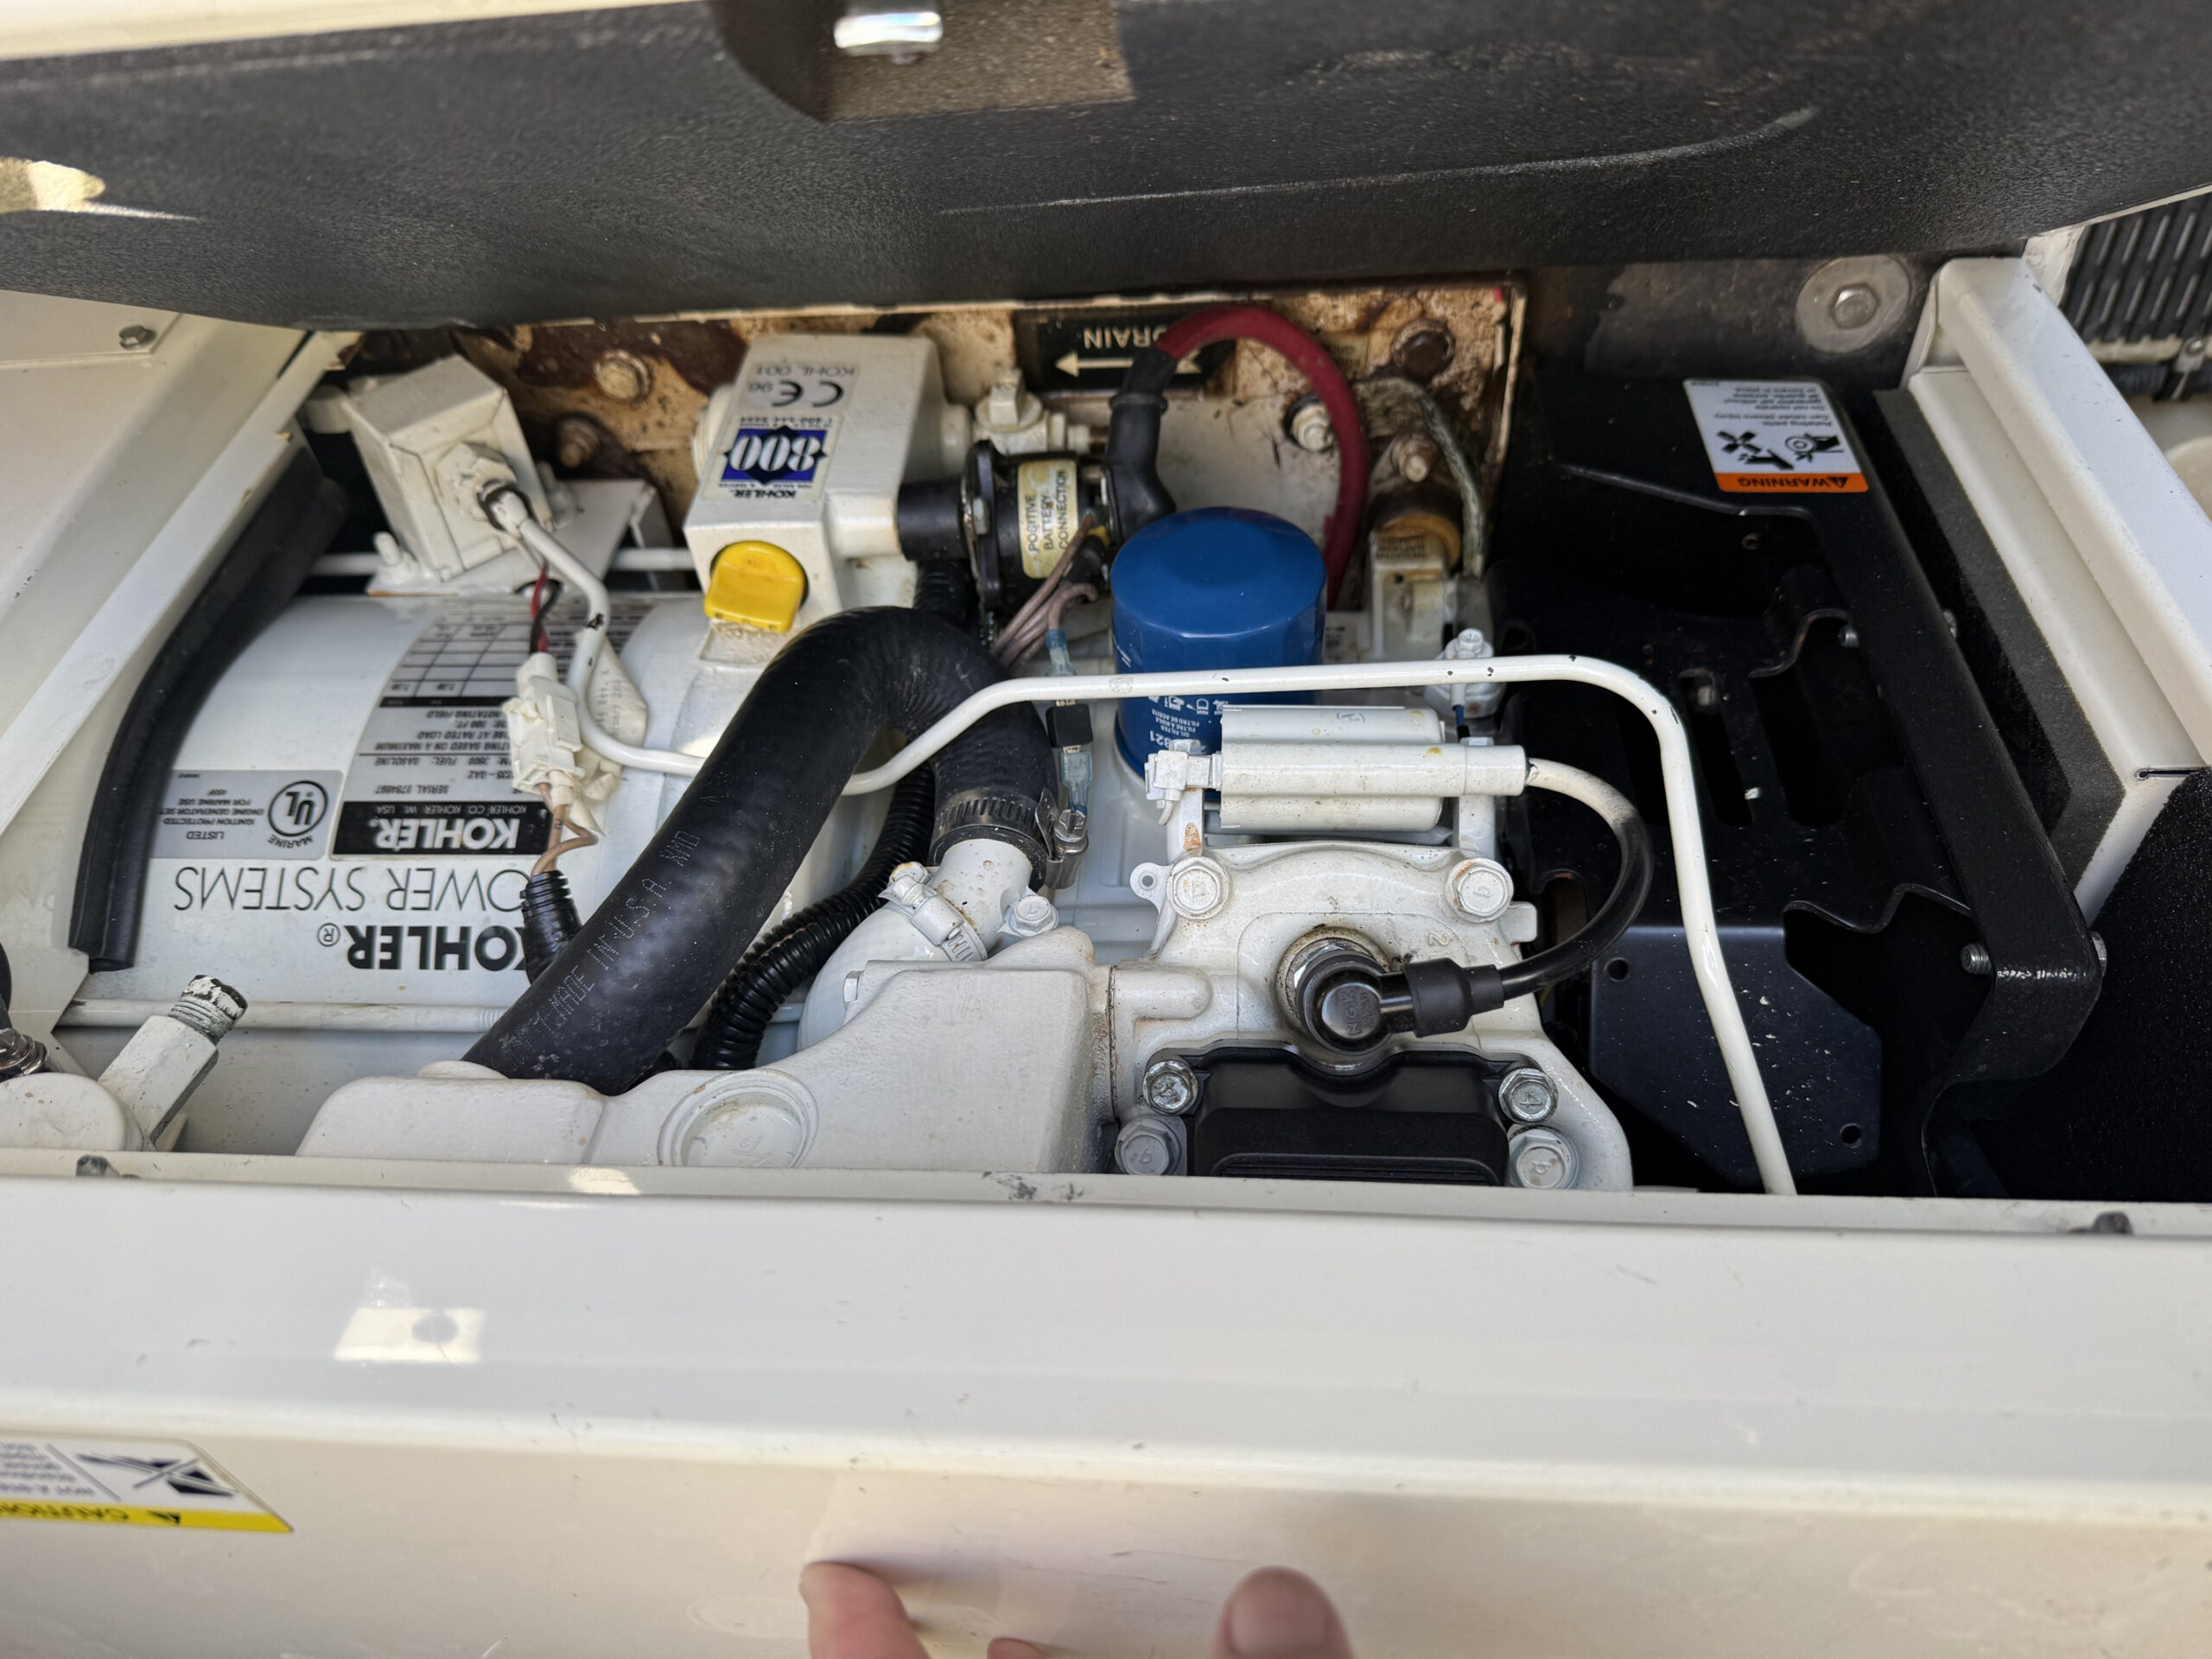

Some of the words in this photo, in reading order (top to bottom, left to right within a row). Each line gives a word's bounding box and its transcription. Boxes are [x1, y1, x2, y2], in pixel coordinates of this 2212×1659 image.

[728, 434, 822, 473] 800
[1737, 477, 1832, 488] WARNING
[1055, 469, 1070, 550] CONNECTION
[1025, 493, 1039, 552] POSITIVE
[1040, 493, 1055, 550] BATTERY
[1149, 709, 1170, 722] ACEITE
[1155, 717, 1171, 728] HUILE
[1175, 724, 1196, 734] FILTRE
[1178, 718, 1199, 728] FILTRO
[1160, 726, 1179, 736] FILTER
[417, 785, 449, 794] SERIAL
[186, 830, 226, 841] LISTED
[268, 834, 314, 849] MARINE
[174, 867, 365, 912] SYSTEMS
[386, 868, 531, 913] OWER
[1341, 990, 1362, 1036] NGK
